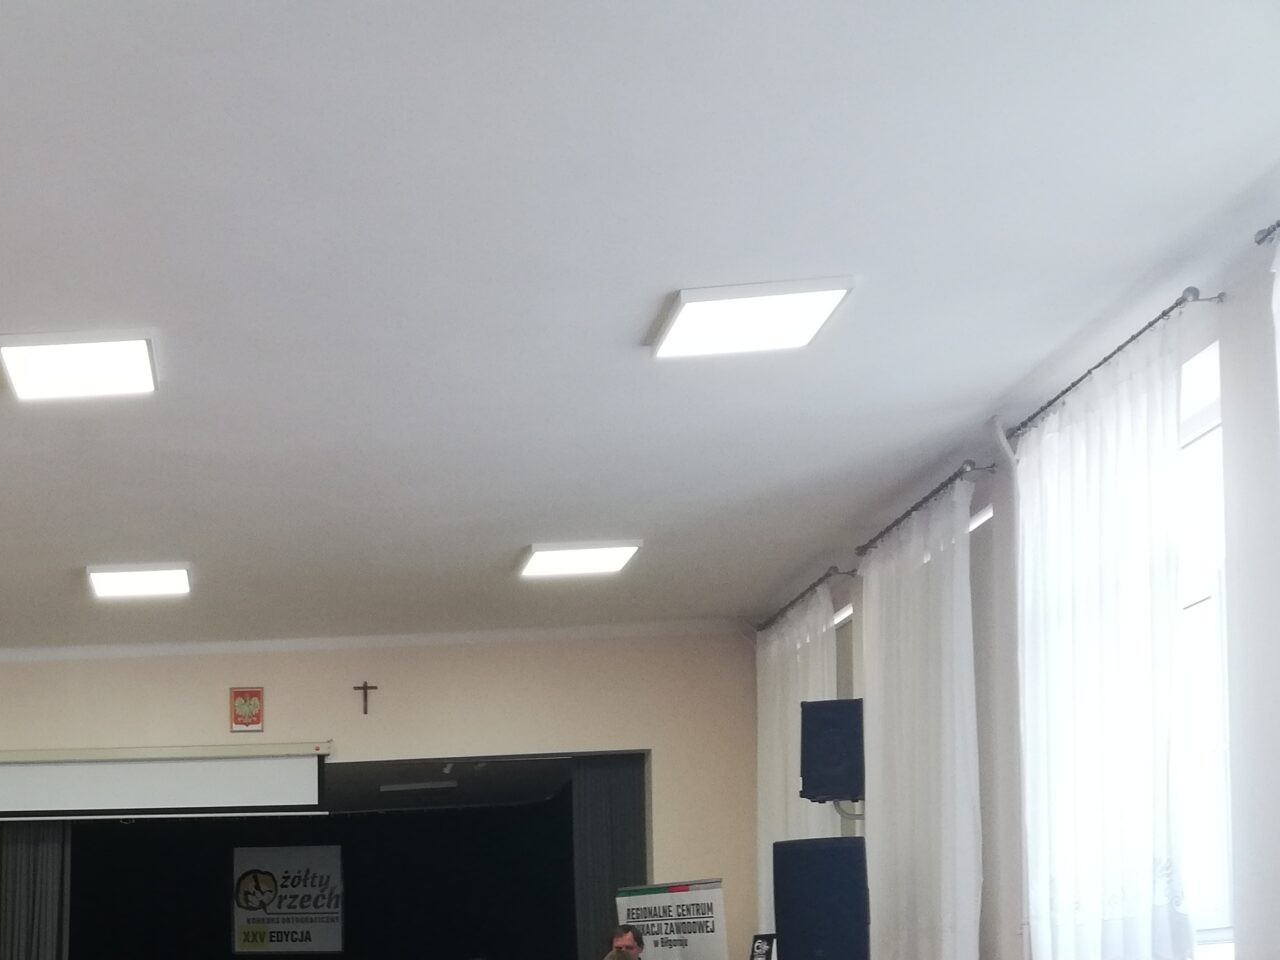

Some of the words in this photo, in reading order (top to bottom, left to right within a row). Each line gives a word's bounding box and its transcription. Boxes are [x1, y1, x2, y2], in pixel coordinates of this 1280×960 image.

[626, 905, 673, 919] REGIONALNE
[676, 902, 714, 917] CENTRUM
[664, 920, 715, 935] ZAWODOWEJ
[242, 931, 266, 943] XXV
[269, 930, 312, 943] EDYCJA
